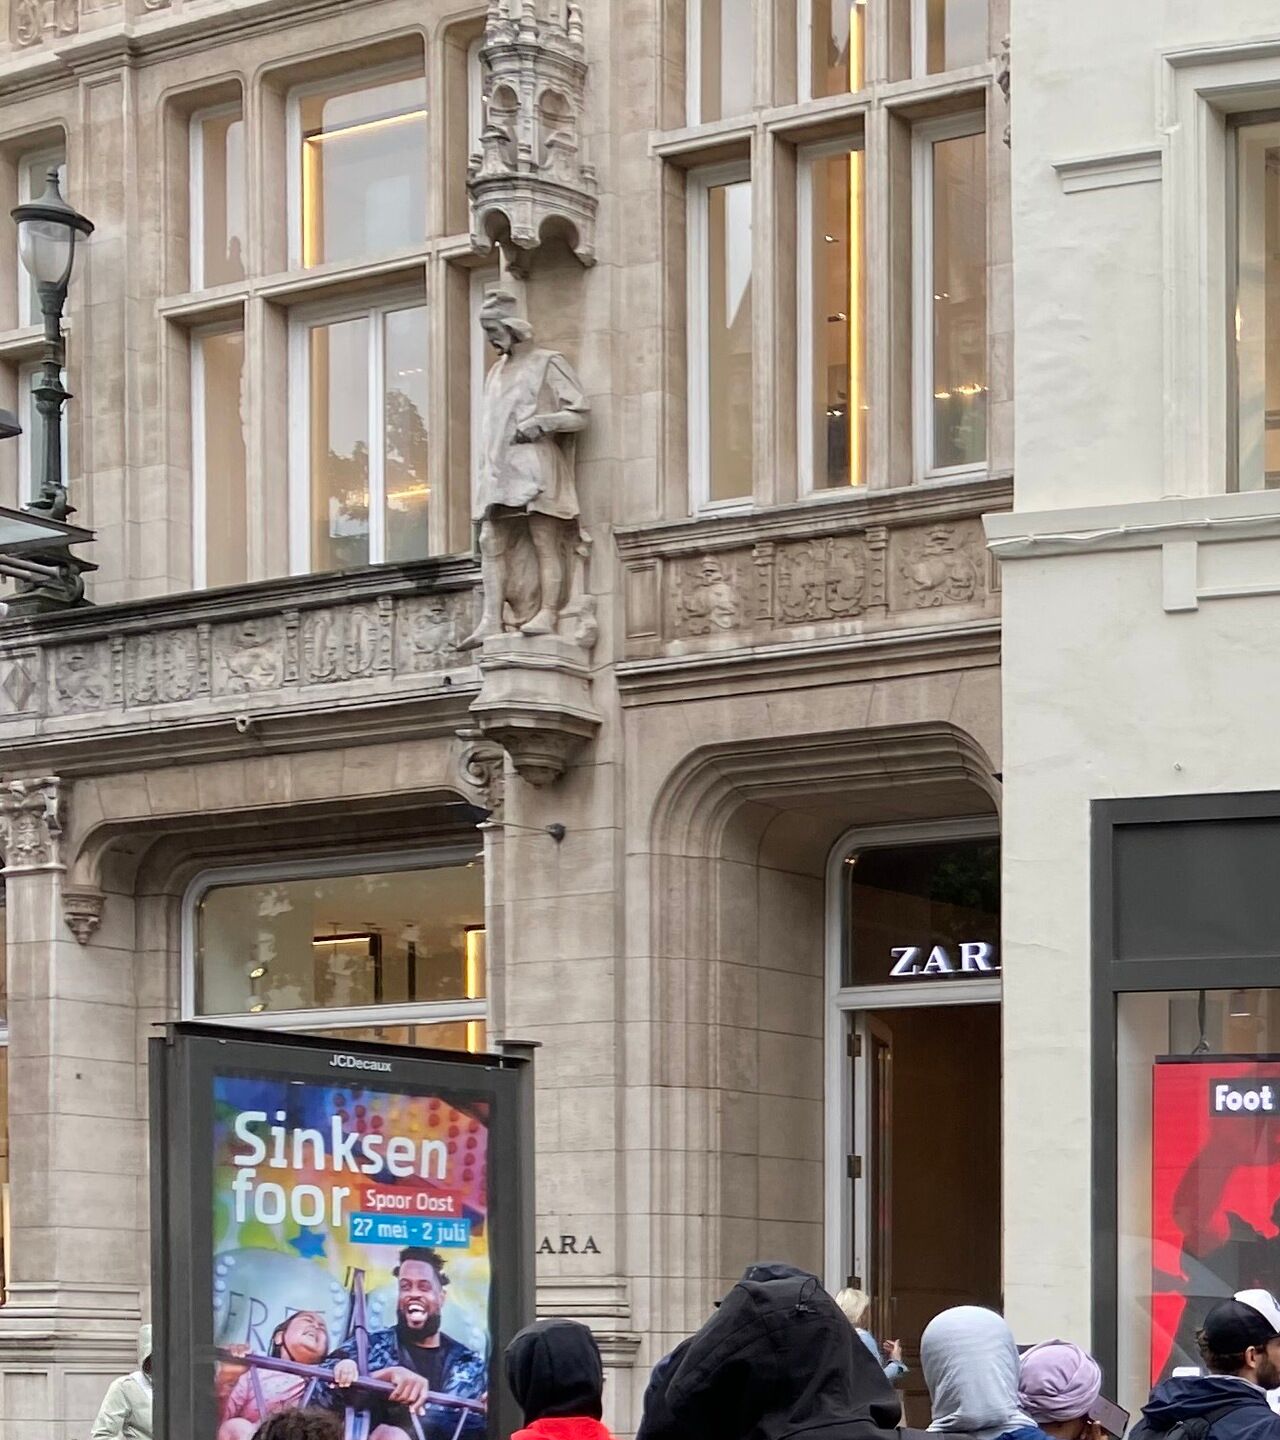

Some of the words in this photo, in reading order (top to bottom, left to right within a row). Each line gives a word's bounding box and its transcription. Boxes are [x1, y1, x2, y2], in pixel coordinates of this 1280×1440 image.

[889, 942, 1001, 976] ZAR
[329, 1054, 392, 1072] JCDecaux
[1215, 1084, 1273, 1111] Foot
[233, 1111, 448, 1180] Sinksen
[232, 1168, 350, 1227] foor
[366, 1189, 411, 1211] Spoor
[416, 1192, 454, 1212] Oost
[353, 1218, 372, 1237] 27
[378, 1220, 408, 1239] mei
[422, 1222, 432, 1241] 2
[435, 1223, 467, 1244] juli
